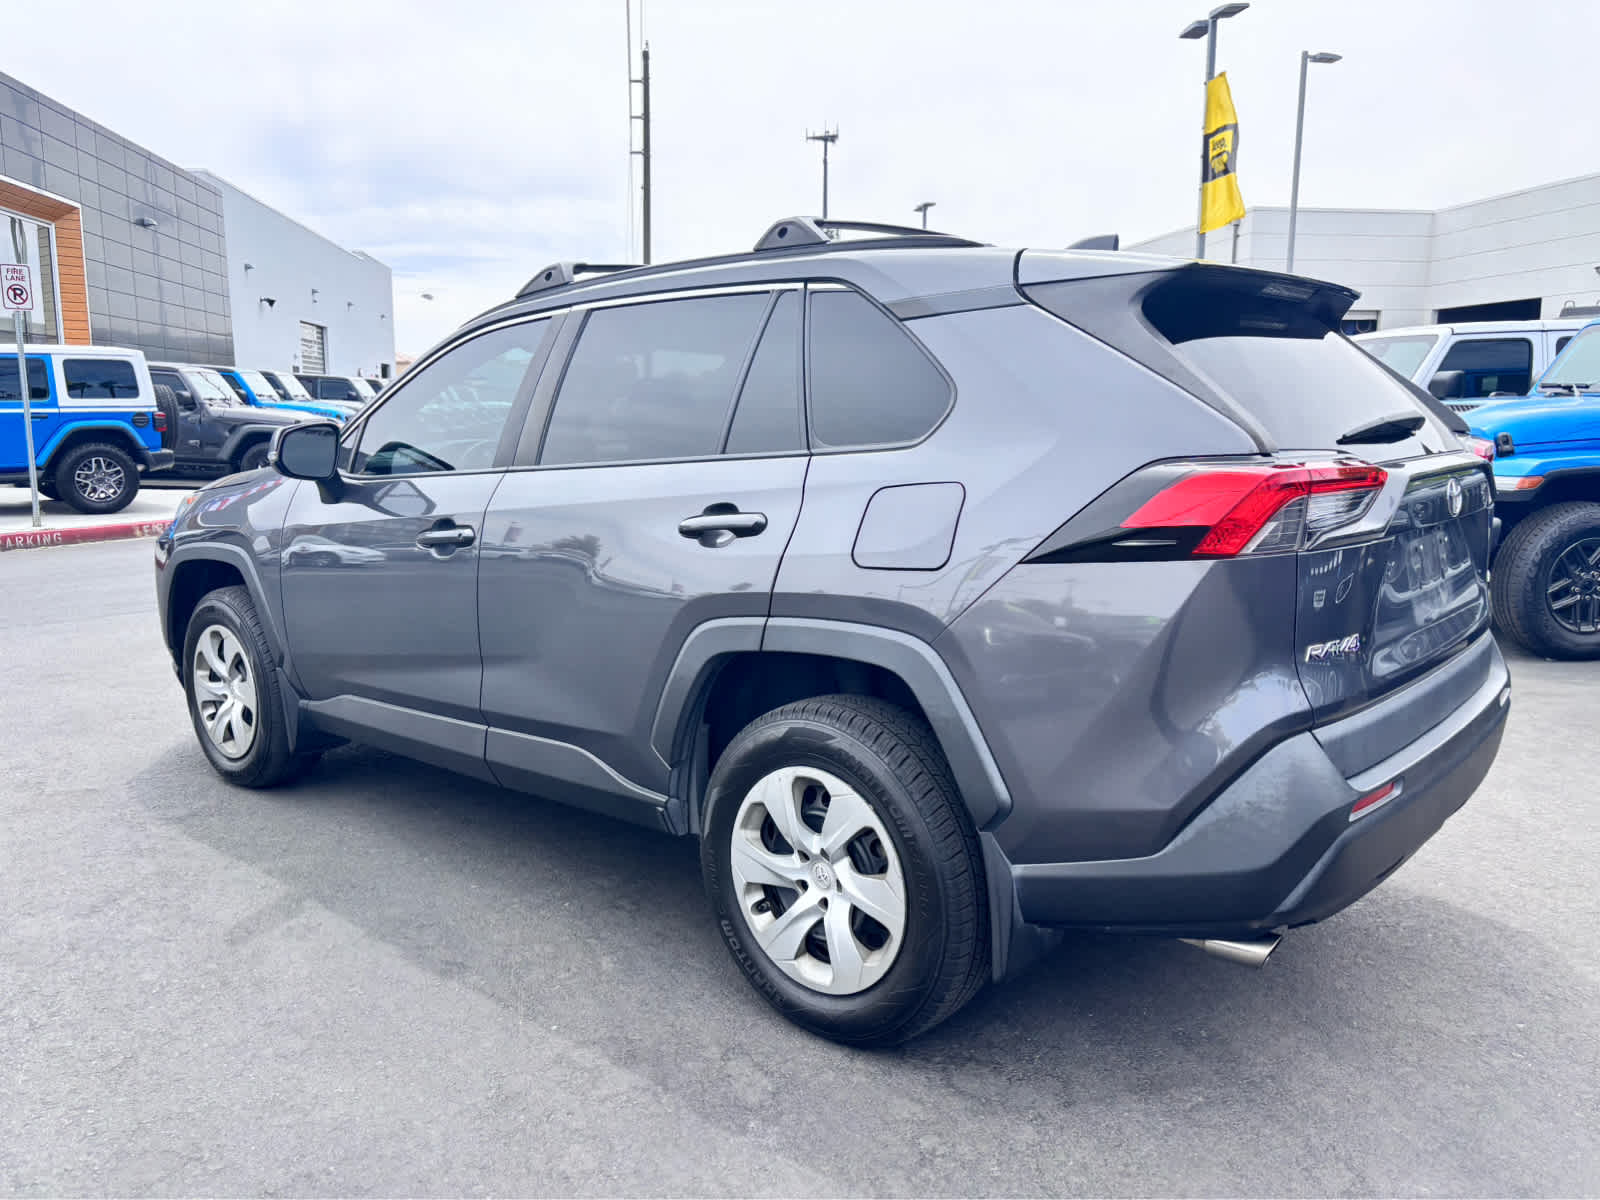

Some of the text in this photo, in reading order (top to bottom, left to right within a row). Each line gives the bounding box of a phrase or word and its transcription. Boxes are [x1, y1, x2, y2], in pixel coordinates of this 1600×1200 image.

[6, 267, 24, 275] FIRE
[5, 274, 26, 282] LANE
[0, 532, 63, 549] ARKING
[1305, 632, 1360, 662] RAV4
